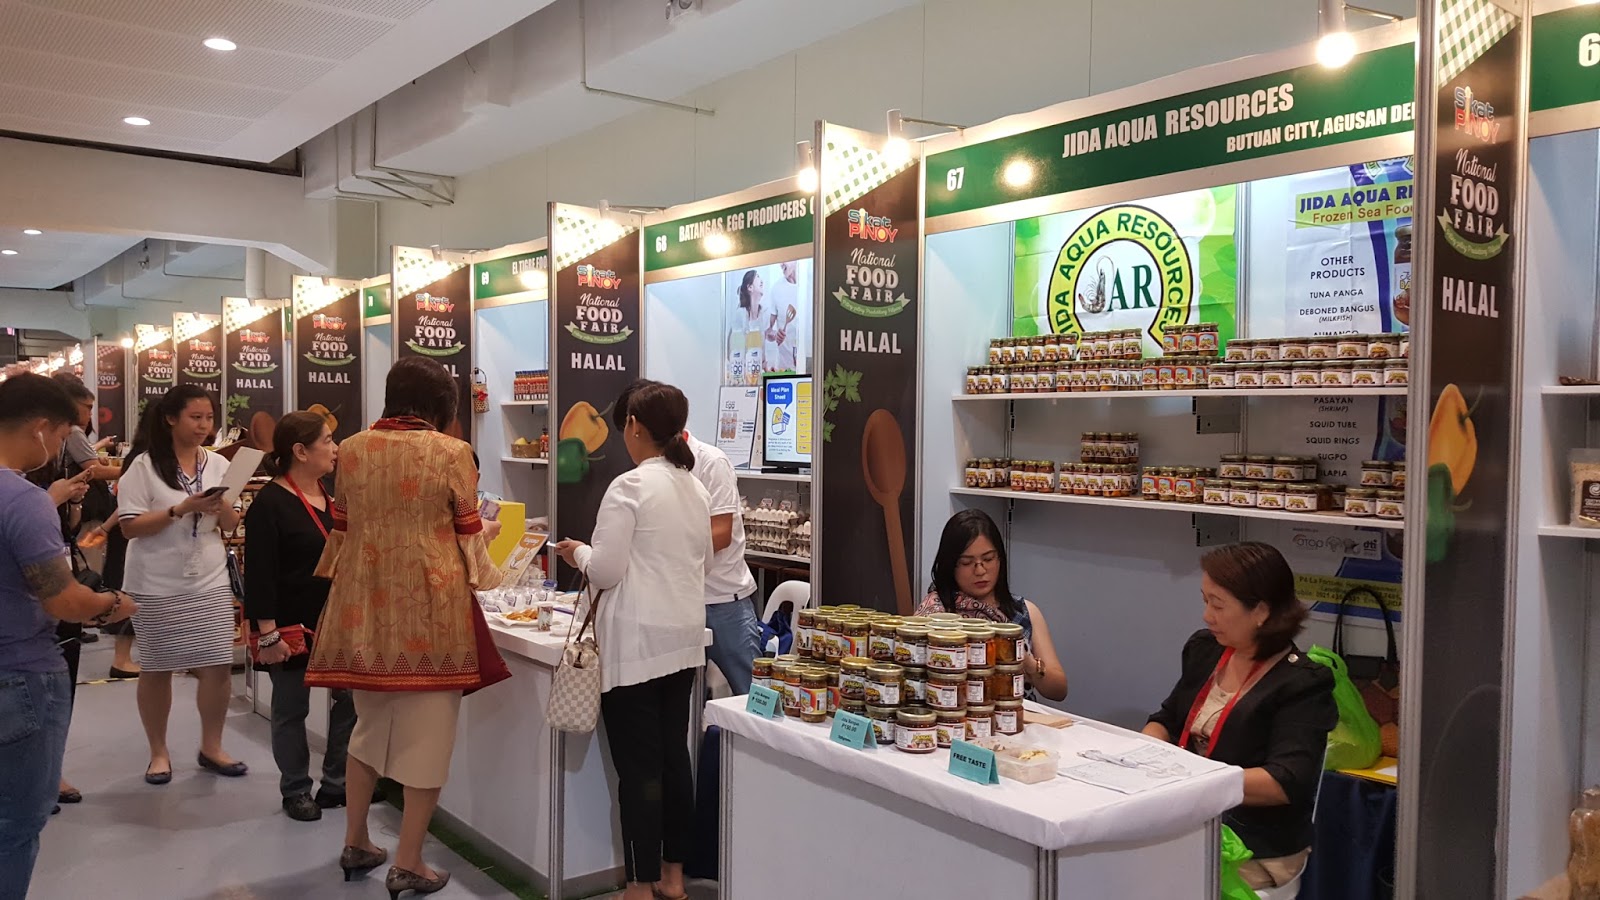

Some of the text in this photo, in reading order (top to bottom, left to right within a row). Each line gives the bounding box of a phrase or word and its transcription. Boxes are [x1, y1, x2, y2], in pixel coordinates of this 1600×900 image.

[1454, 86, 1495, 121] Sikat
[1062, 83, 1294, 158] JIDA AQUA RESOURCES
[1455, 108, 1500, 144] PINOY
[1226, 131, 1281, 153] BUTUAN
[1456, 148, 1497, 183] National
[946, 167, 964, 191] 67
[1300, 195, 1336, 214] JIDA
[1341, 187, 1390, 206] AQUA
[1450, 174, 1499, 216] FOOD
[679, 217, 723, 242] BATANGAS
[727, 212, 745, 232] EGG
[747, 198, 807, 228] PRODUCERS
[848, 208, 892, 228] Sikat
[1313, 211, 1353, 223] Frozen
[1358, 207, 1381, 218] Sea
[1453, 208, 1495, 238] FAIR
[849, 221, 898, 243] PINOY
[655, 235, 667, 253] 68
[1059, 219, 1110, 281] AQUA
[851, 248, 895, 267] National
[1321, 255, 1354, 266] OTHER
[846, 265, 899, 288] FOOD
[1310, 267, 1365, 280] PRODUCTS
[580, 293, 620, 307] National
[851, 286, 894, 303] FAIR
[1310, 289, 1364, 299] TUNA PANGA
[1442, 277, 1499, 318] HALAL
[576, 306, 623, 323] FOOD
[1300, 305, 1375, 316] DEBONED BANGUS
[418, 316, 453, 327] National
[580, 321, 619, 333] FAIR
[415, 326, 456, 339] FOOD
[312, 341, 348, 352] FOOD
[419, 338, 452, 347] FAIR
[840, 329, 901, 354] HALAL
[189, 359, 217, 368] FOOD
[239, 352, 271, 361] FOOD
[571, 353, 626, 371] HALAL
[236, 379, 273, 389] HALAL
[309, 372, 350, 384] HALAL
[1310, 421, 1357, 429] SQUID TUBE
[1306, 436, 1360, 445] SQUID RINGS
[1317, 453, 1347, 461] SUGPO
[953, 752, 987, 770] FREE TASTE
